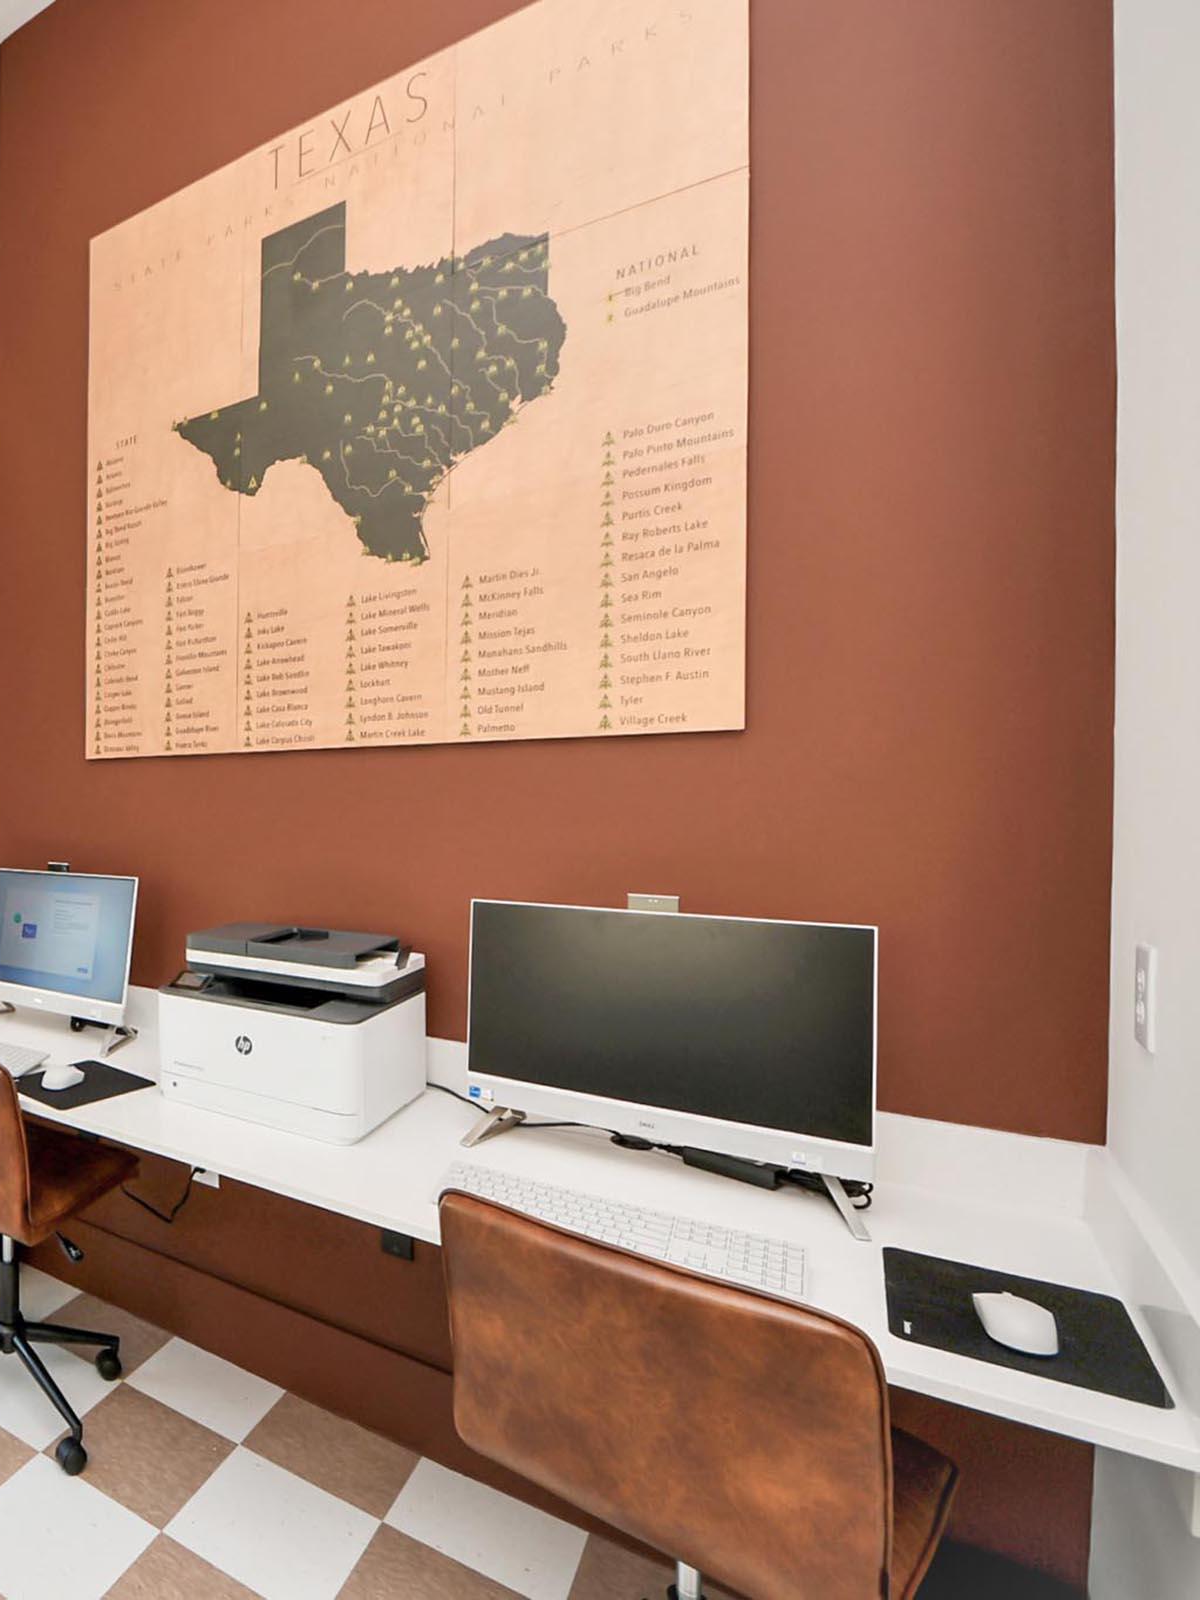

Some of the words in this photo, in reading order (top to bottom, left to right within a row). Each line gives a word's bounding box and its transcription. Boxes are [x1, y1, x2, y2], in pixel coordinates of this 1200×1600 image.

[268, 72, 428, 190] TEXAS
[616, 244, 700, 279] NATIONAL
[624, 285, 641, 297] Big
[644, 274, 671, 291] Bend
[683, 276, 740, 300] Mountains
[623, 429, 644, 439] Palo
[647, 423, 672, 433] Duro
[675, 412, 714, 427] Canyon
[623, 449, 644, 459] Palo
[647, 442, 673, 454] Pinto
[676, 428, 734, 448] Mountains
[623, 460, 679, 478] Pedernales
[682, 454, 705, 465] Falls
[622, 486, 661, 500] Possum
[664, 476, 712, 492] Kingdom
[622, 509, 650, 521] Purtis
[654, 502, 682, 515] Creek
[622, 531, 639, 542] Ray
[643, 524, 681, 538] Roberts
[685, 519, 708, 531] Lake
[659, 546, 672, 556] de
[675, 544, 683, 554] la
[687, 539, 720, 550] Palma
[479, 572, 507, 584] Martin
[510, 570, 528, 580] Dies
[621, 572, 639, 583] San
[642, 566, 679, 580] Angelo
[361, 594, 377, 604] Lake
[379, 588, 417, 599] Livingston
[479, 590, 521, 602] McKinney
[524, 586, 544, 597] Falls
[621, 593, 639, 603] Sea
[642, 590, 661, 600] Rim
[361, 611, 377, 621] Lake
[379, 606, 407, 617] Mineral
[409, 603, 430, 613] Wells
[479, 608, 518, 620] Meridian
[621, 609, 668, 624] Seminole
[672, 605, 711, 618] Canyon
[361, 628, 376, 637] Lake
[379, 622, 418, 634] Somerville
[478, 629, 512, 640] Mission
[514, 627, 535, 637] Tejas
[621, 631, 662, 644] Sheldon
[666, 628, 688, 639] Lake
[361, 645, 376, 654] Lake
[478, 647, 523, 658] Monahans
[526, 641, 567, 654] Sandhills
[621, 652, 649, 663] South
[653, 649, 680, 661] Llano
[684, 647, 711, 657] River
[360, 662, 376, 672] Lake
[378, 659, 409, 670] Whitney
[478, 667, 509, 678] Mother
[512, 664, 530, 674] Neff
[360, 679, 390, 688] Lockhart
[621, 673, 662, 685] Stephen
[676, 669, 709, 680] Austin
[478, 684, 515, 696] Mustang
[518, 682, 545, 693] Island
[360, 695, 394, 706] Longhorn
[396, 693, 422, 702] Cavern
[620, 695, 643, 706] Tyler
[478, 705, 492, 715] Old
[495, 703, 524, 714] Tunnel
[360, 713, 386, 724] Lyndon
[396, 711, 429, 720] Johnson
[620, 714, 655, 727] Village
[658, 712, 687, 723] Creek
[360, 730, 383, 739] Martin
[385, 728, 405, 738] Creek
[408, 728, 425, 737] Lake
[477, 723, 515, 733] Palmetto
[235, 1035, 253, 1056] hp
